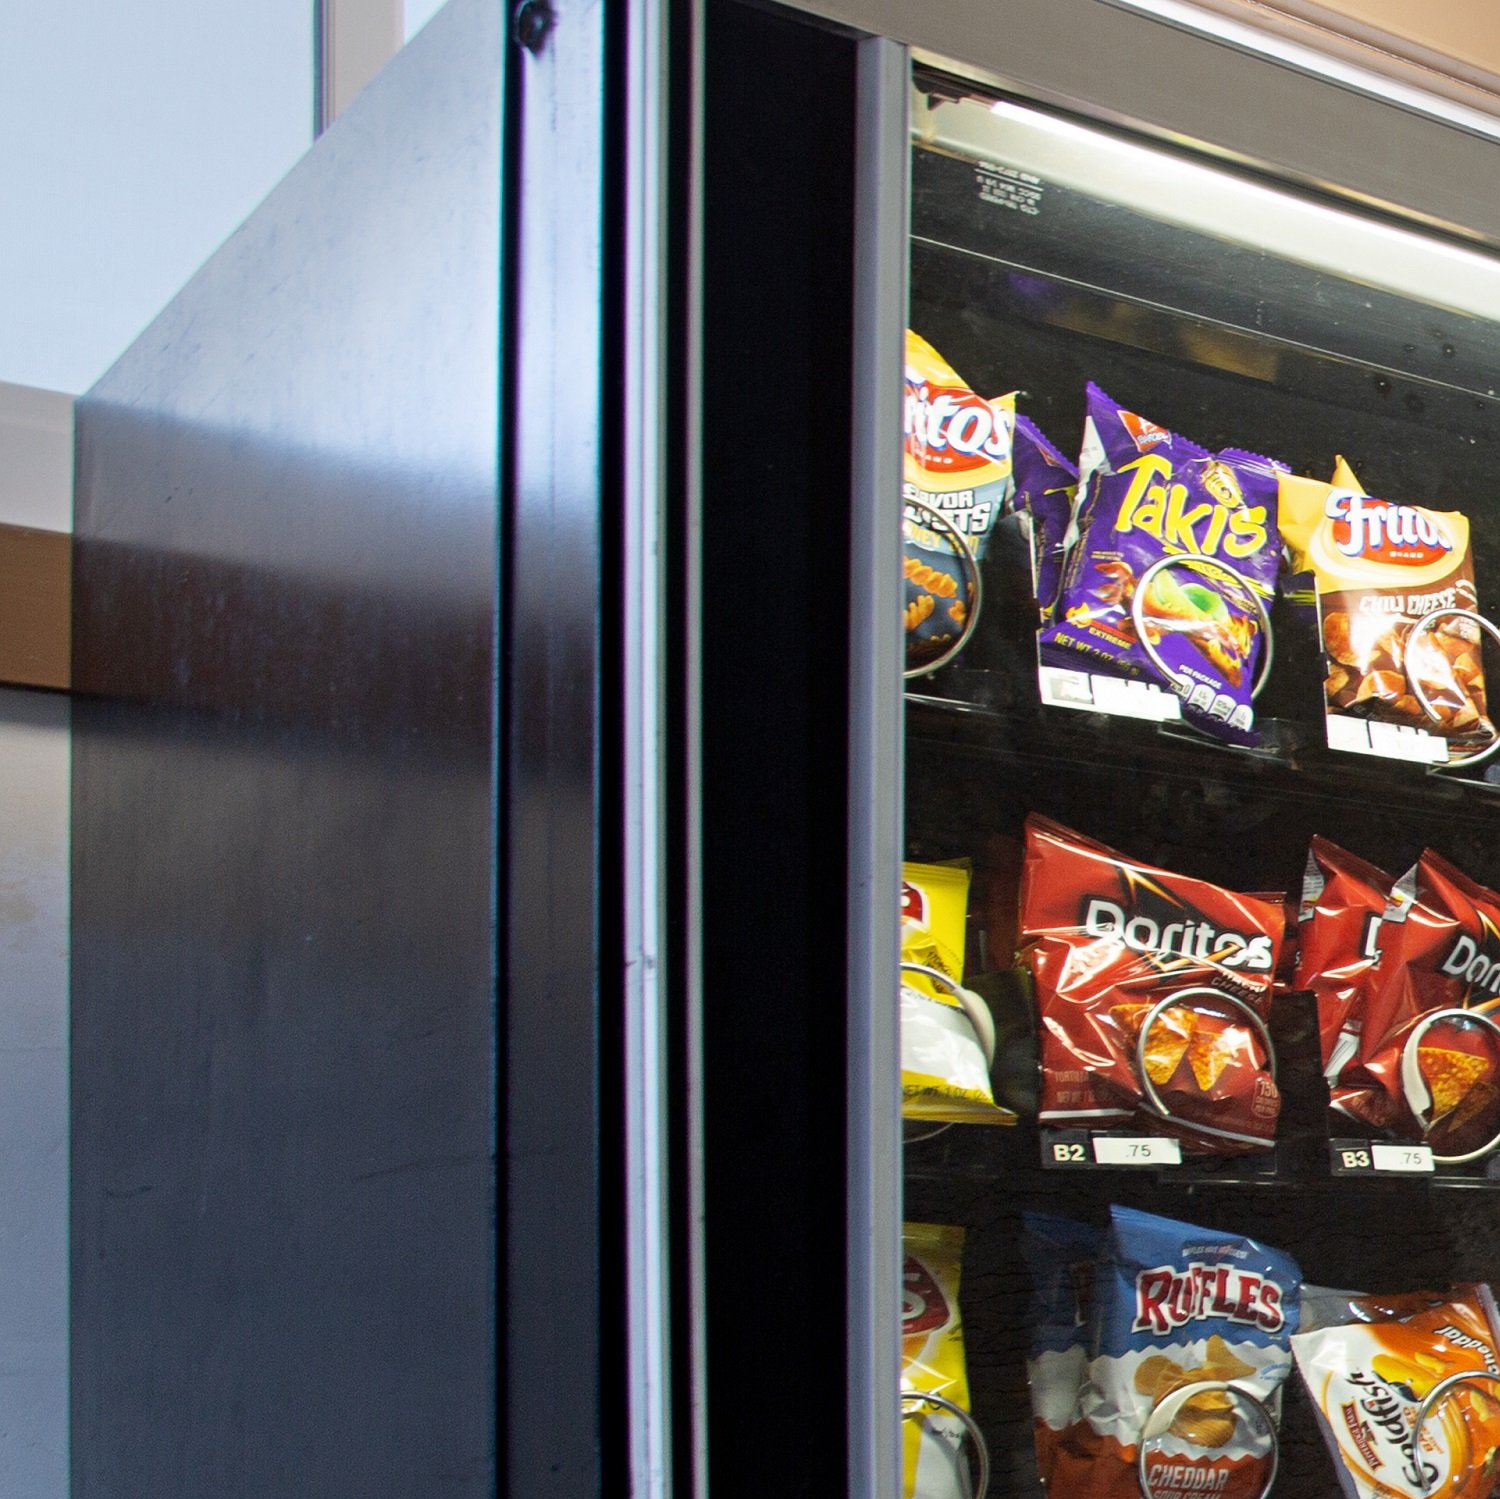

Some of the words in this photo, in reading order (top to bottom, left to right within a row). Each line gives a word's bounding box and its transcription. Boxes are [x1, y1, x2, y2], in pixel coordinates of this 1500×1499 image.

[1114, 454, 1268, 557] Takis
[1359, 594, 1403, 615] CHILI
[1406, 586, 1458, 616] CHEESE
[1054, 632, 1073, 647] NET
[1075, 639, 1093, 653] WT
[1088, 626, 1132, 650] EXTREME
[1084, 899, 1275, 970] Doritos
[1210, 975, 1265, 1006] CHEESE
[1052, 1143, 1087, 1162] B2
[1126, 1144, 1153, 1158] .75
[1341, 1151, 1371, 1168] B3
[1132, 1262, 1286, 1335] RUFFLES
[1345, 1369, 1439, 1491] Goldfish
[1354, 1424, 1382, 1469] PEPPERIDGE
[1150, 1463, 1231, 1491] CHEDDAR
